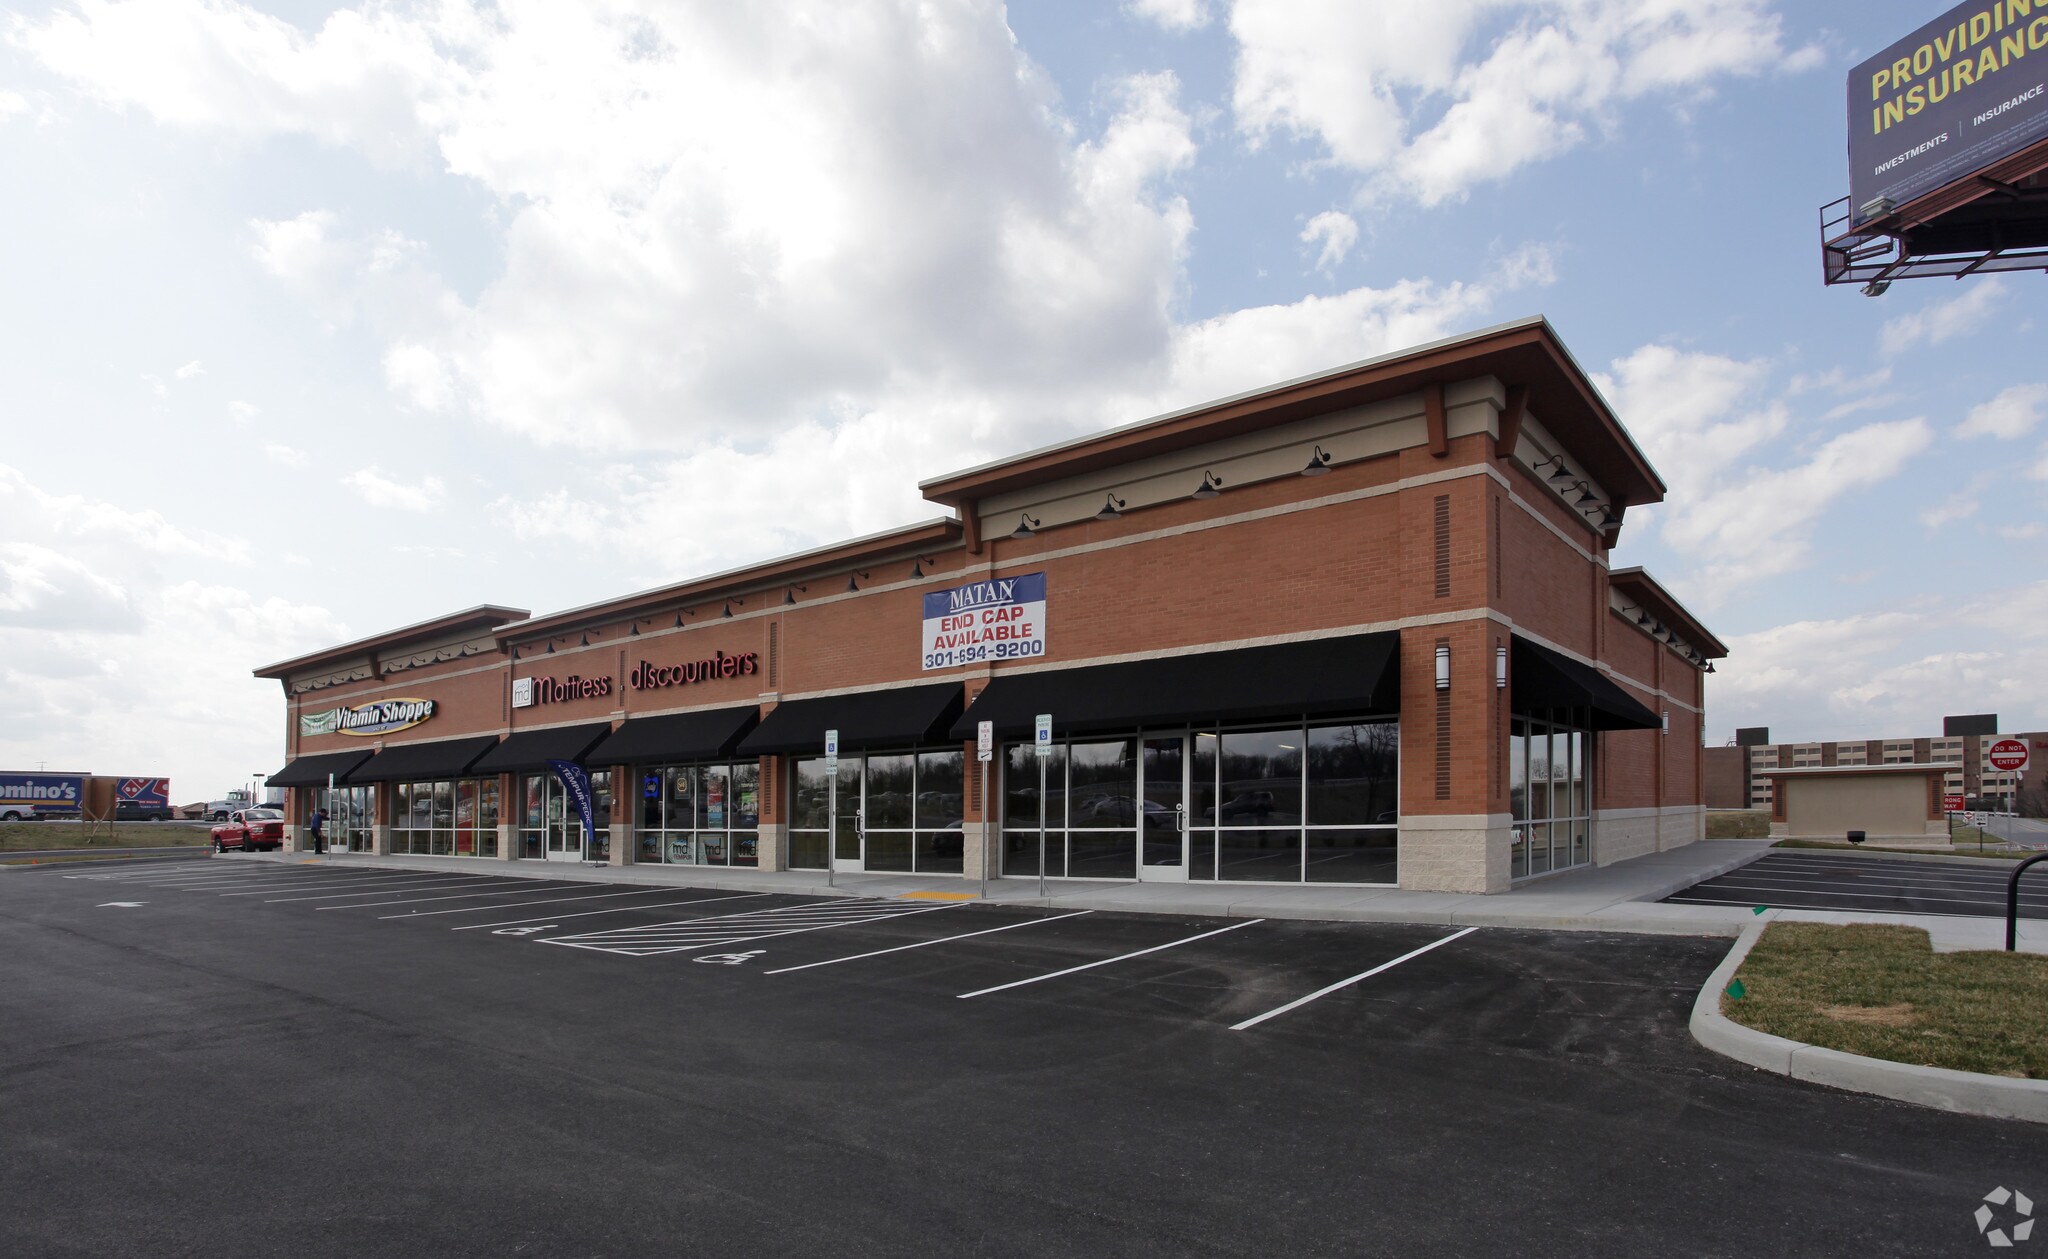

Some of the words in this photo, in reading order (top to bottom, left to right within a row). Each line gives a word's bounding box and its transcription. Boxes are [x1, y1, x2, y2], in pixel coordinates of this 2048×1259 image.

[1872, 0, 2048, 100] PROVIDIN
[1874, 132, 1949, 176] INVESTMENTS
[1973, 84, 2045, 127] INSURANCE
[950, 579, 1014, 610] MATAN
[941, 613, 975, 633] END
[982, 606, 1024, 625] CAP
[934, 623, 1033, 651] AVAILABLE
[925, 639, 1043, 668] 301-694-9200
[631, 651, 754, 689] discounters
[336, 705, 380, 730] Vitamin
[381, 699, 433, 723] Shoppe
[0, 780, 76, 799] mino's
[562, 767, 591, 824] TEMPUR-PEDIC
